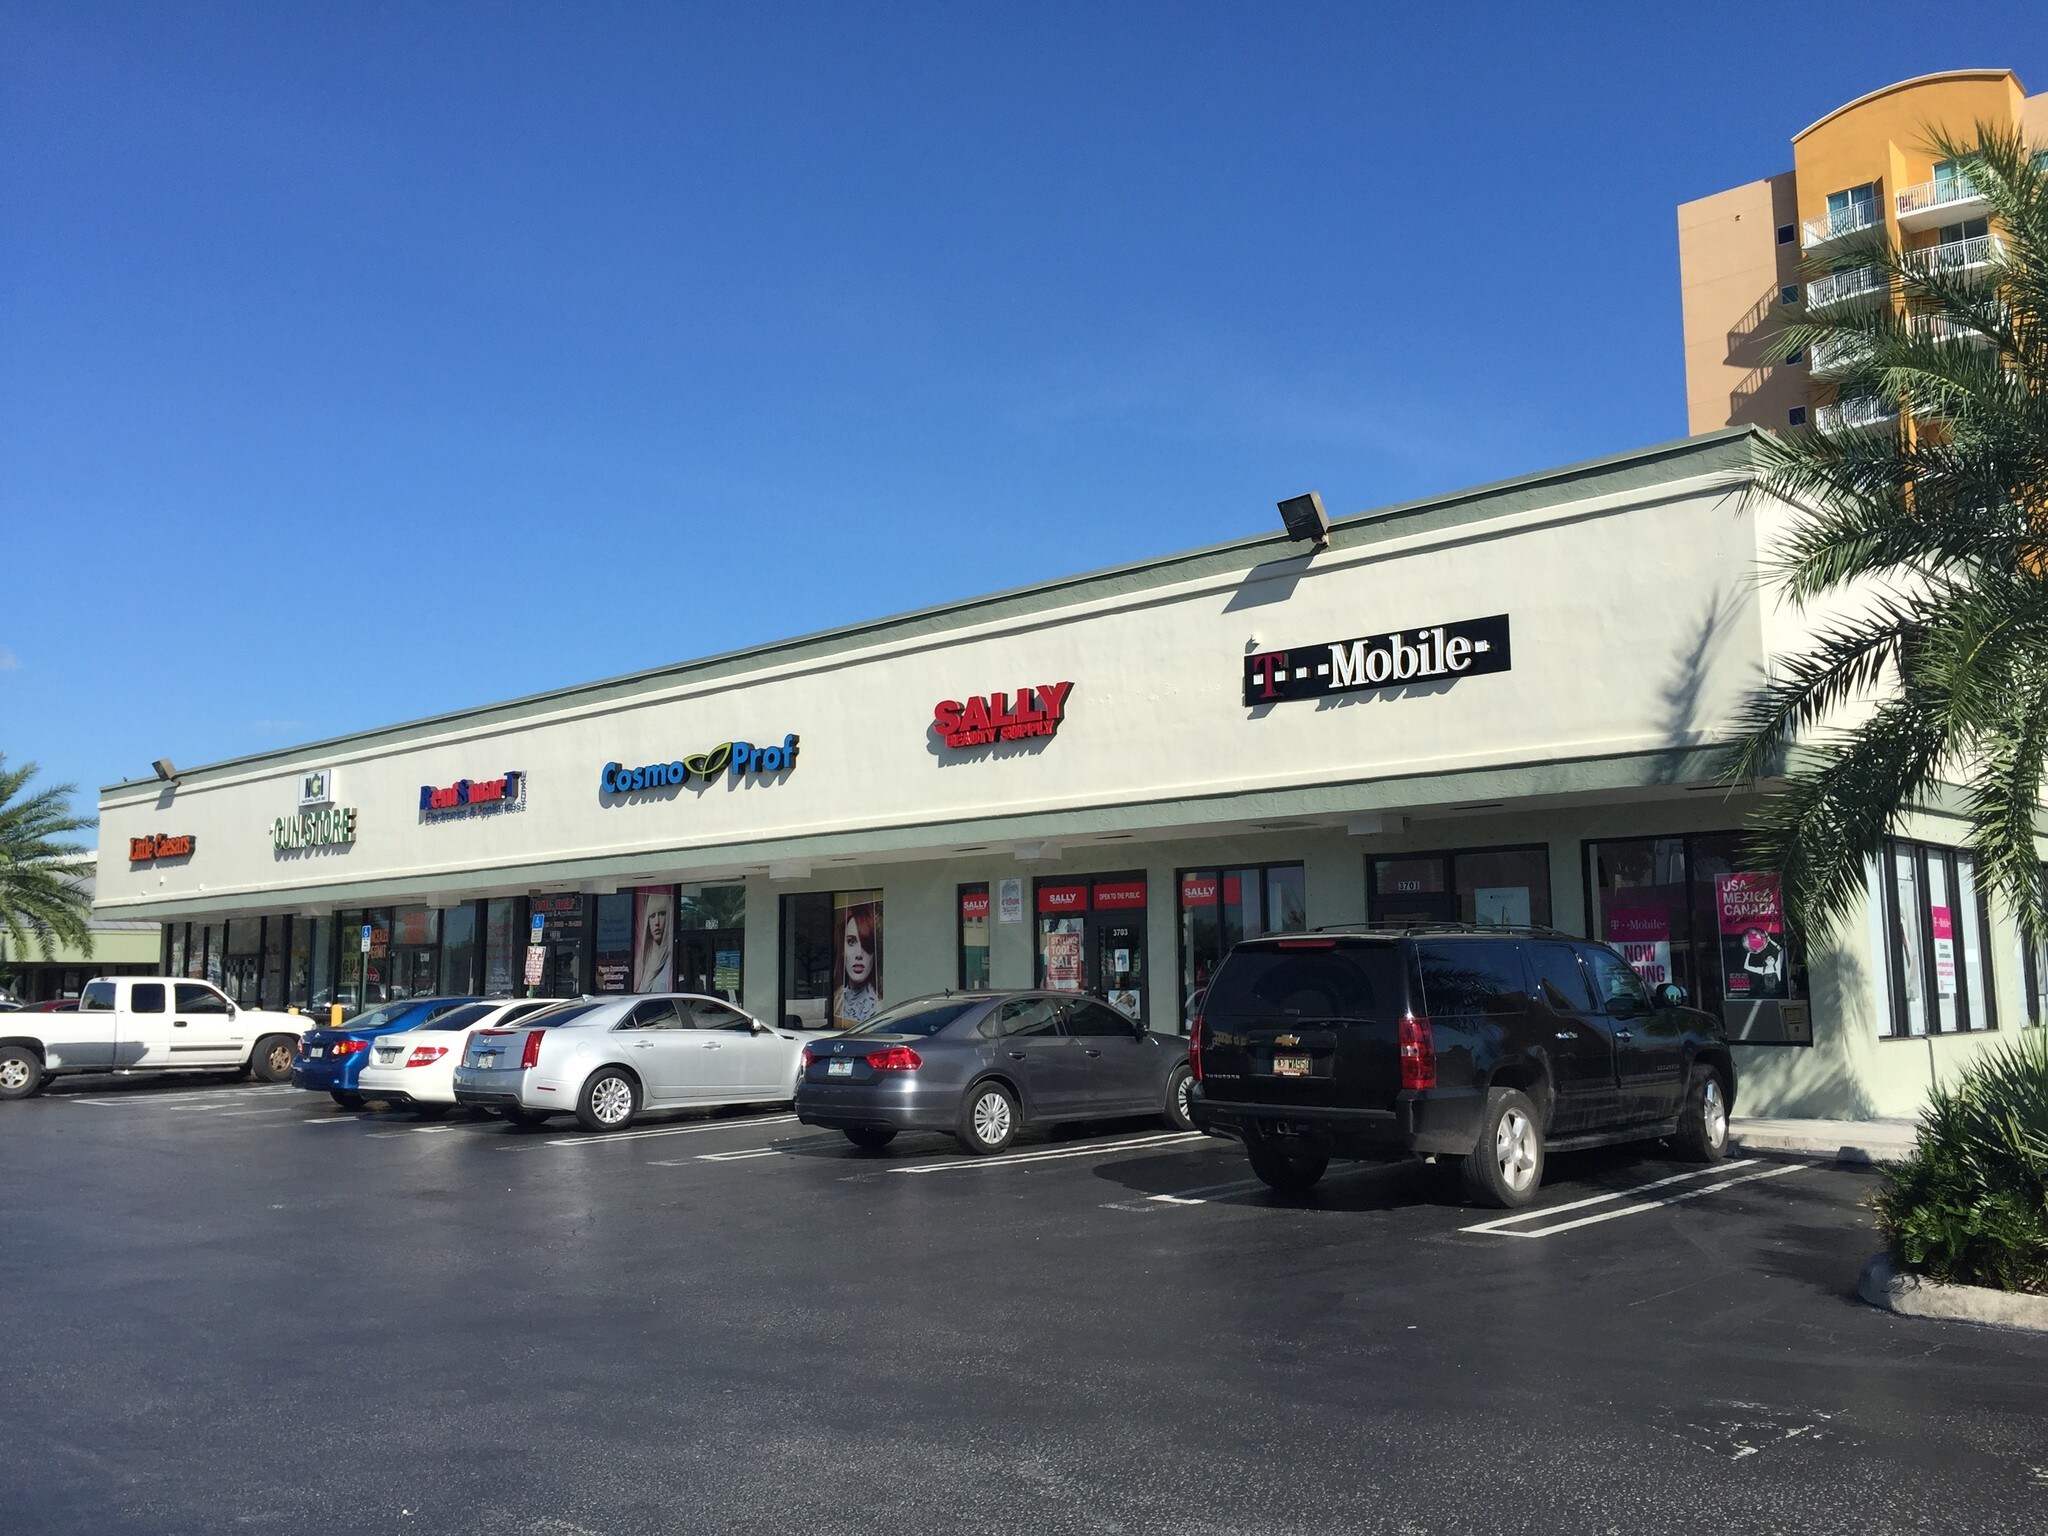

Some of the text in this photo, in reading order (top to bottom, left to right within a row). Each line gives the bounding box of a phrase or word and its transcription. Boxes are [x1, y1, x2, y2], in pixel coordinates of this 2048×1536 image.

[933, 681, 1073, 736] SALLY
[945, 720, 1055, 748] BEAUTY SUPPLY
[601, 733, 799, 793] Cosmo Prof
[274, 807, 356, 850] GUN STORE
[129, 833, 195, 861] Little Caesars
[1184, 886, 1215, 896] SALLY
[1722, 879, 1747, 891] USA
[1049, 893, 1077, 902] SALLY
[963, 900, 989, 909] SALLY
[1112, 928, 1128, 937] 3703
[1050, 936, 1078, 945] STYLING
[1051, 945, 1077, 955] TOOLS
[1624, 944, 1656, 962] NOW
[1051, 956, 1078, 968] SALE
